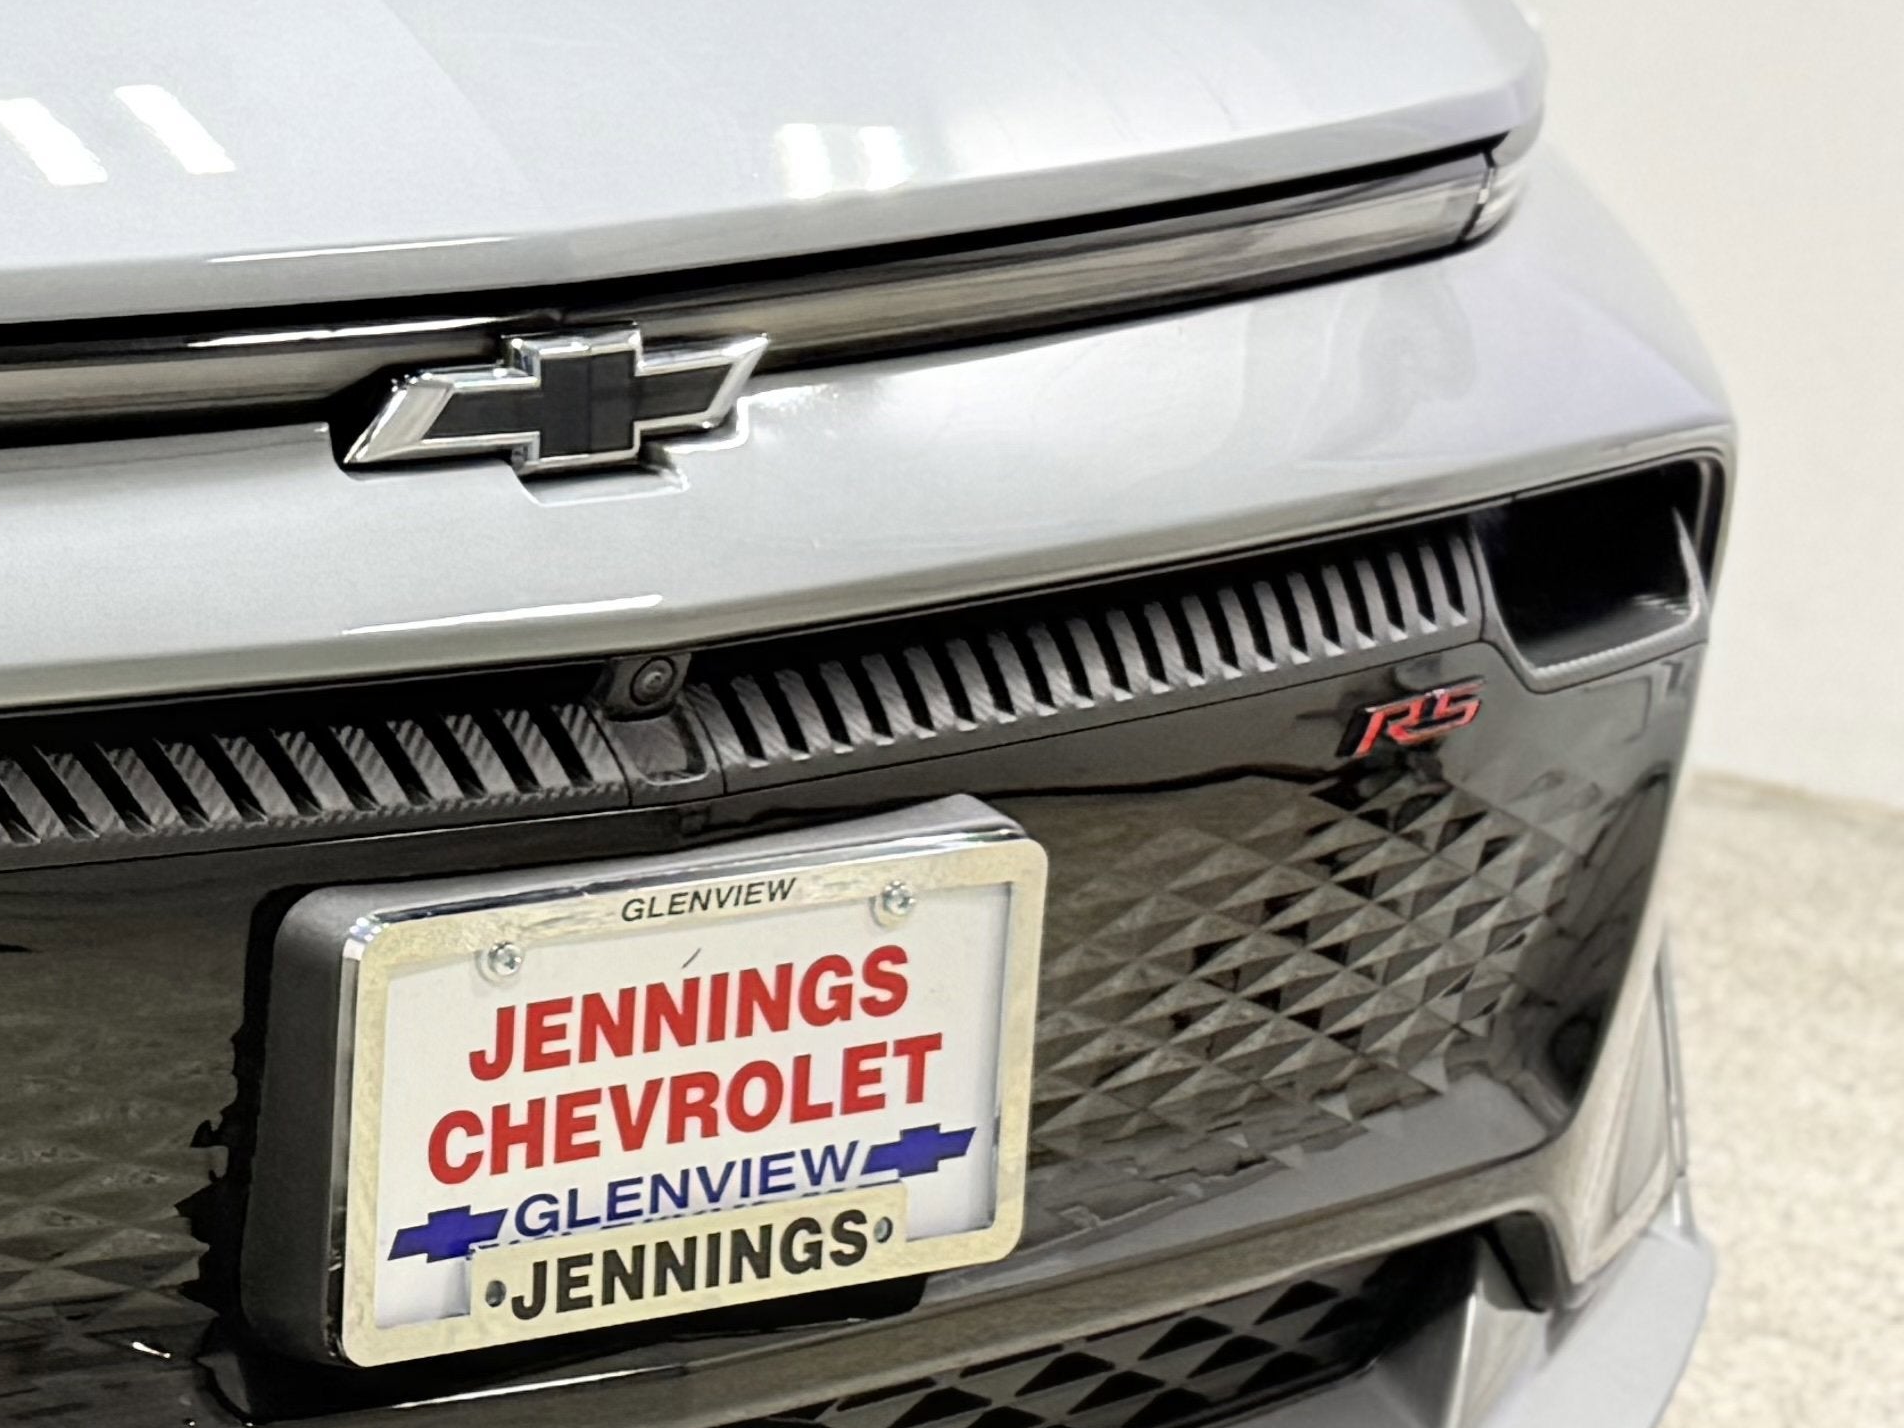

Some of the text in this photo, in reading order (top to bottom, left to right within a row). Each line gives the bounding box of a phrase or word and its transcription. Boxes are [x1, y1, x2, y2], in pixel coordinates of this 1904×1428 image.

[1342, 678, 1484, 759] RS
[621, 877, 796, 922] GLENVIEW
[469, 945, 909, 1081] JENNINGS
[428, 1033, 943, 1186] CHEVROLET
[514, 1140, 861, 1238] GLENVIEW
[511, 1208, 868, 1321] JENNINGS
